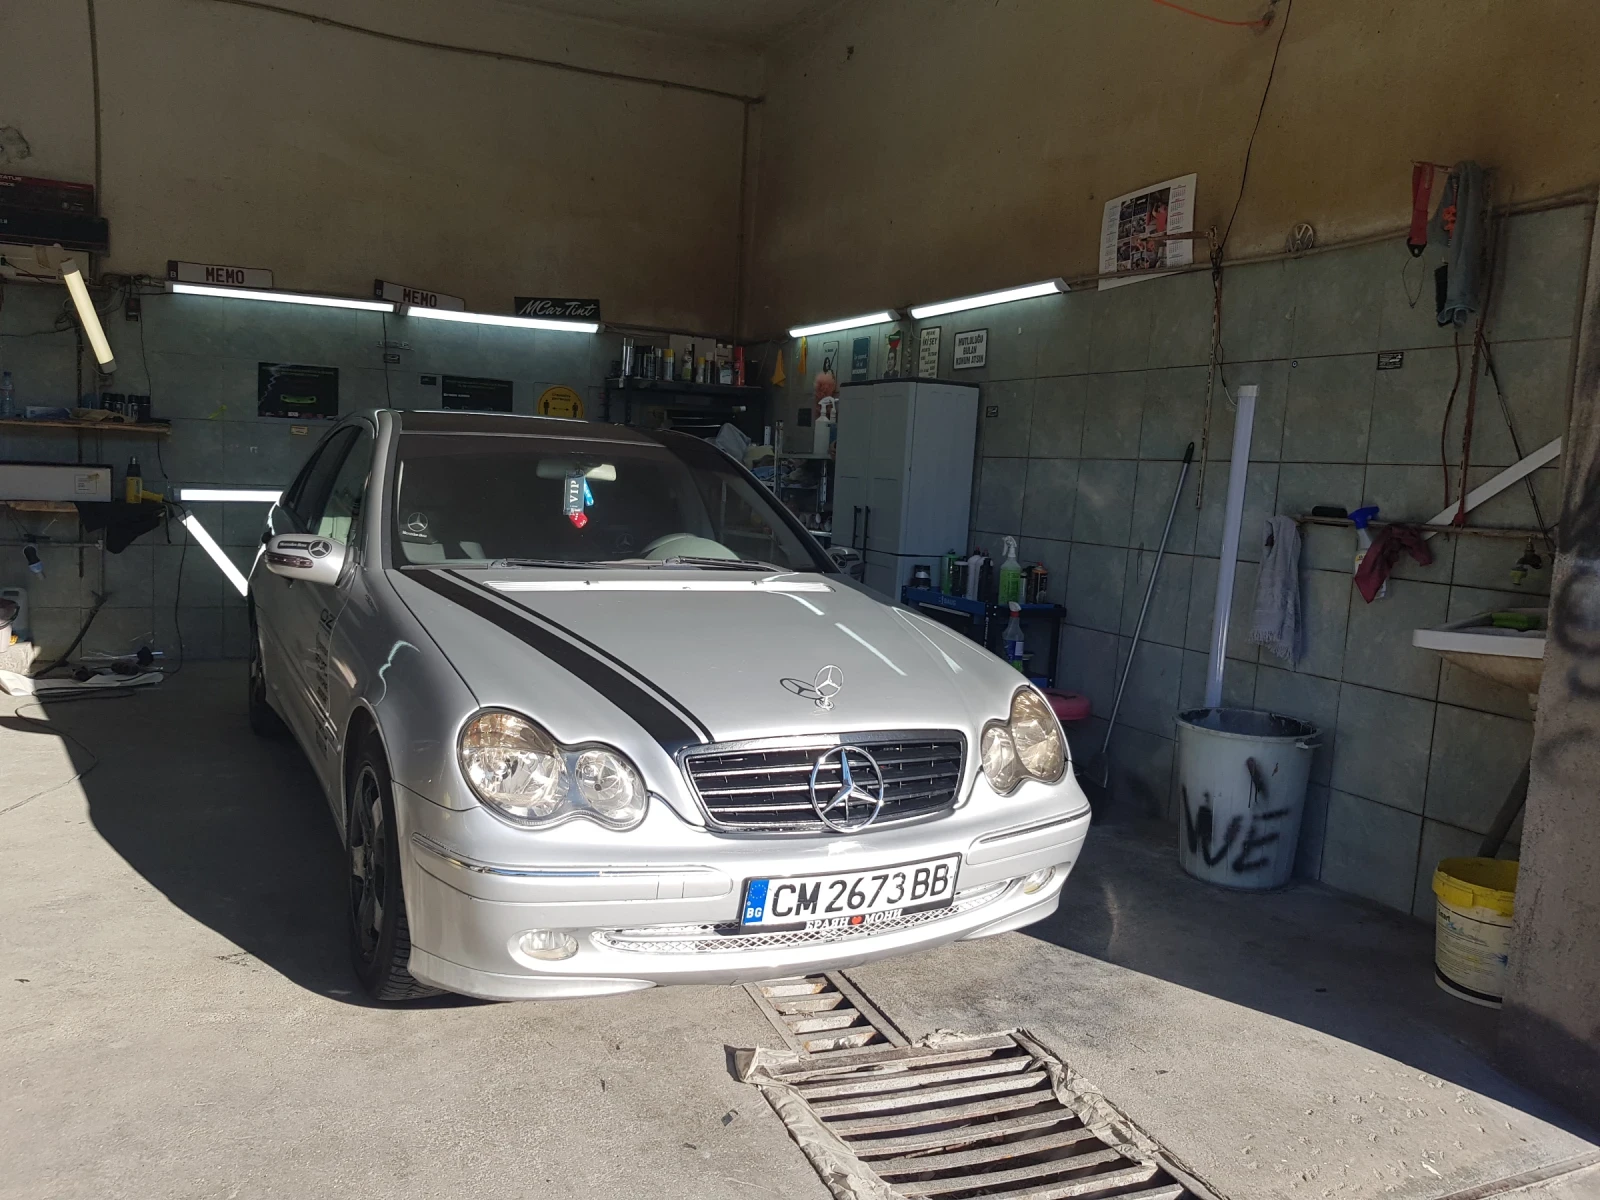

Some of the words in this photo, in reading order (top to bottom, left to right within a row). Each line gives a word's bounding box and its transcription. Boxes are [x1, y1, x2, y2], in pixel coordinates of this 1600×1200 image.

[205, 267, 245, 284] MEMO
[403, 288, 437, 307] MEMO
[570, 480, 580, 503] VIP
[746, 907, 763, 918] BG
[805, 917, 850, 931] БРАЯН
[864, 908, 904, 924] МОНИ
